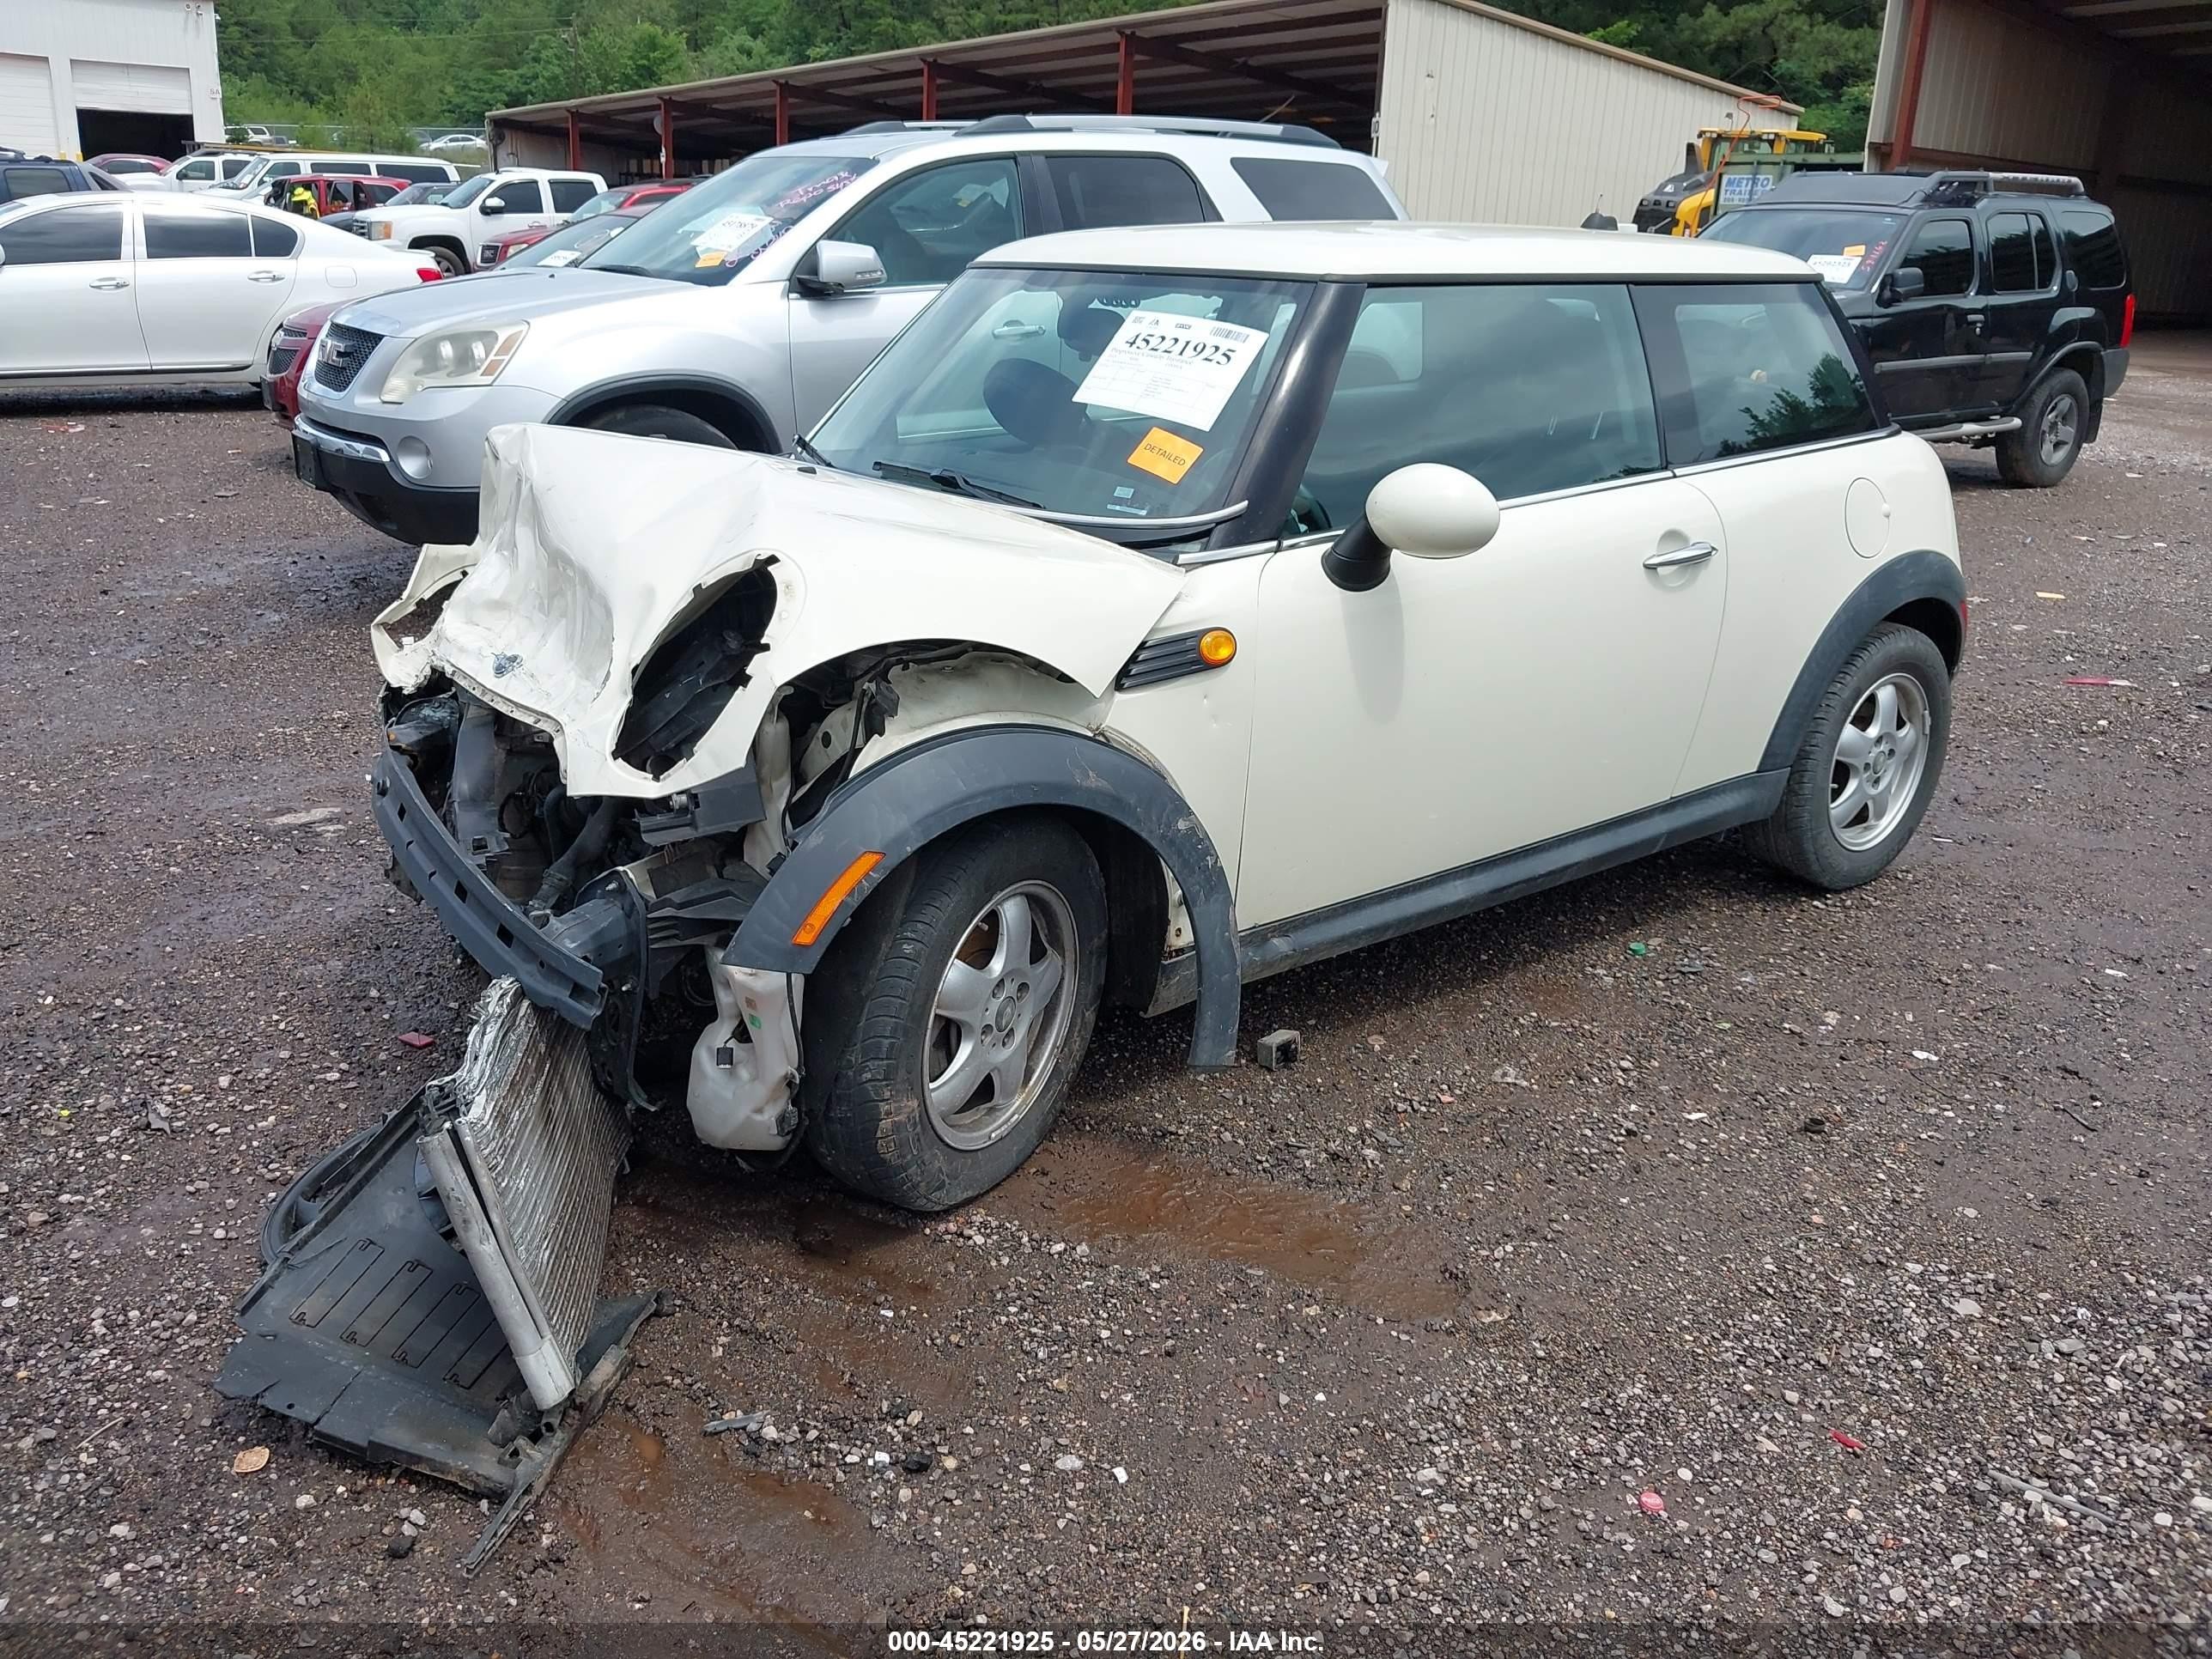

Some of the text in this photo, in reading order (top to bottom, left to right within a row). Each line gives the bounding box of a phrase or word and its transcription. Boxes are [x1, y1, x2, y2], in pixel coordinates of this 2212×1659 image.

[1725, 177, 1771, 189] METRO
[1724, 189, 1769, 198] TRAILE
[1125, 332, 1237, 366] 45221925
[1144, 443, 1186, 466] DETAILED
